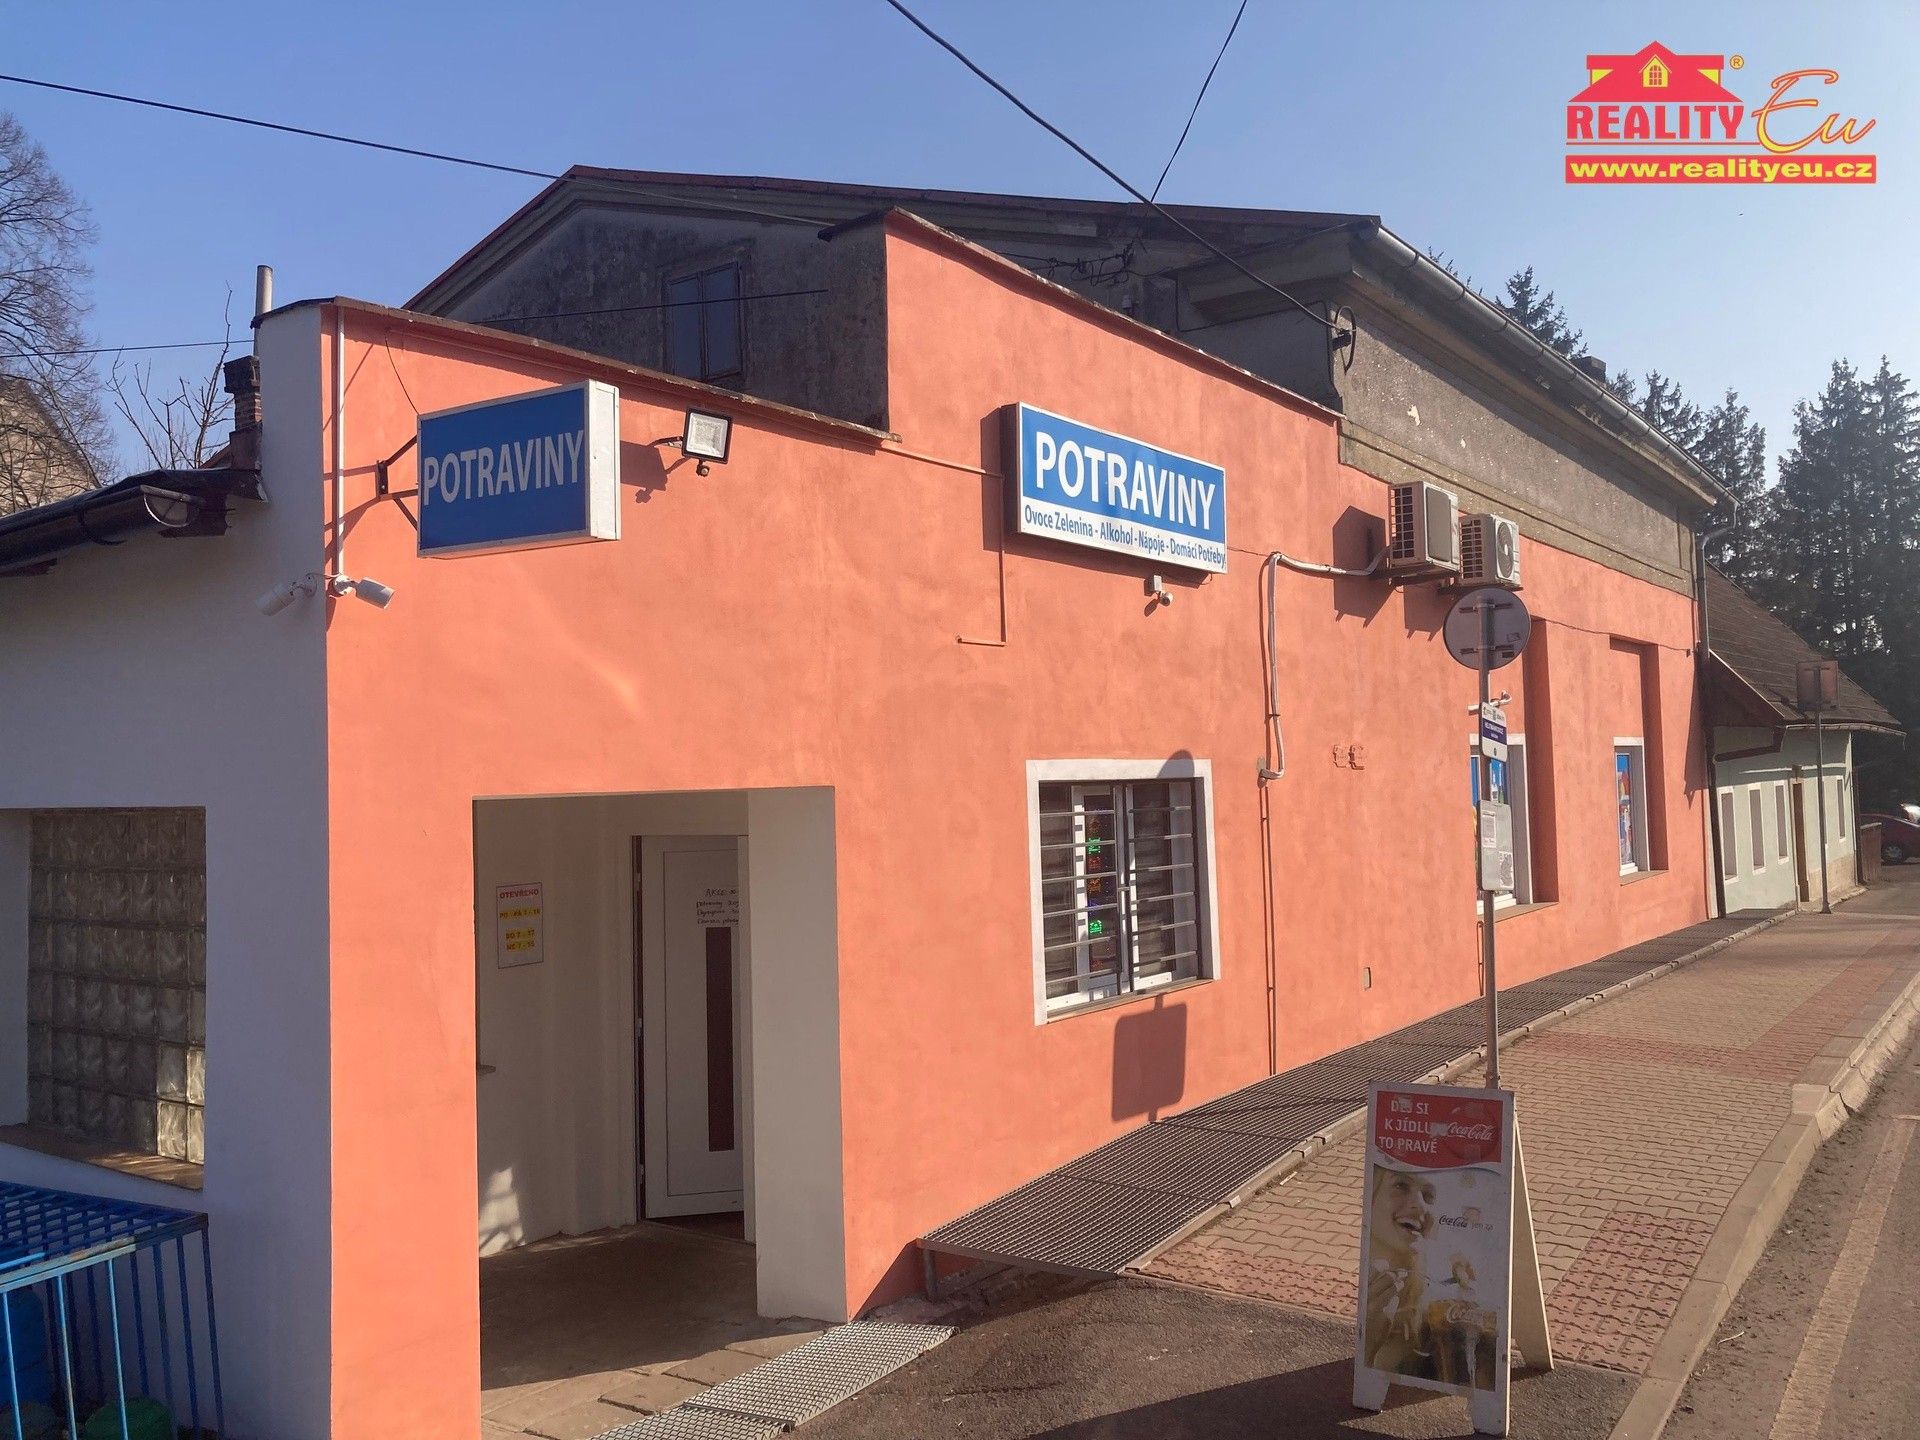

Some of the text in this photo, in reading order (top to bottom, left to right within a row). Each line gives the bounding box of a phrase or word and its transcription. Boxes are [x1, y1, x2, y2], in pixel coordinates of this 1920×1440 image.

[423, 430, 584, 506] POTRAVINY
[1036, 431, 1216, 530] POTRAVINY
[1025, 505, 1053, 529] Ovoce
[1055, 512, 1093, 537] Zelenina
[1100, 522, 1133, 544] Alkohol
[1138, 530, 1165, 556] Nápoje
[1170, 538, 1197, 560] Domácí
[1198, 545, 1226, 567] Potřeby
[499, 889, 539, 899] OTEVŘENO
[1416, 1102, 1429, 1115] SI
[1384, 1118, 1393, 1130] K
[1378, 1136, 1438, 1154] TO PRAVÉ
